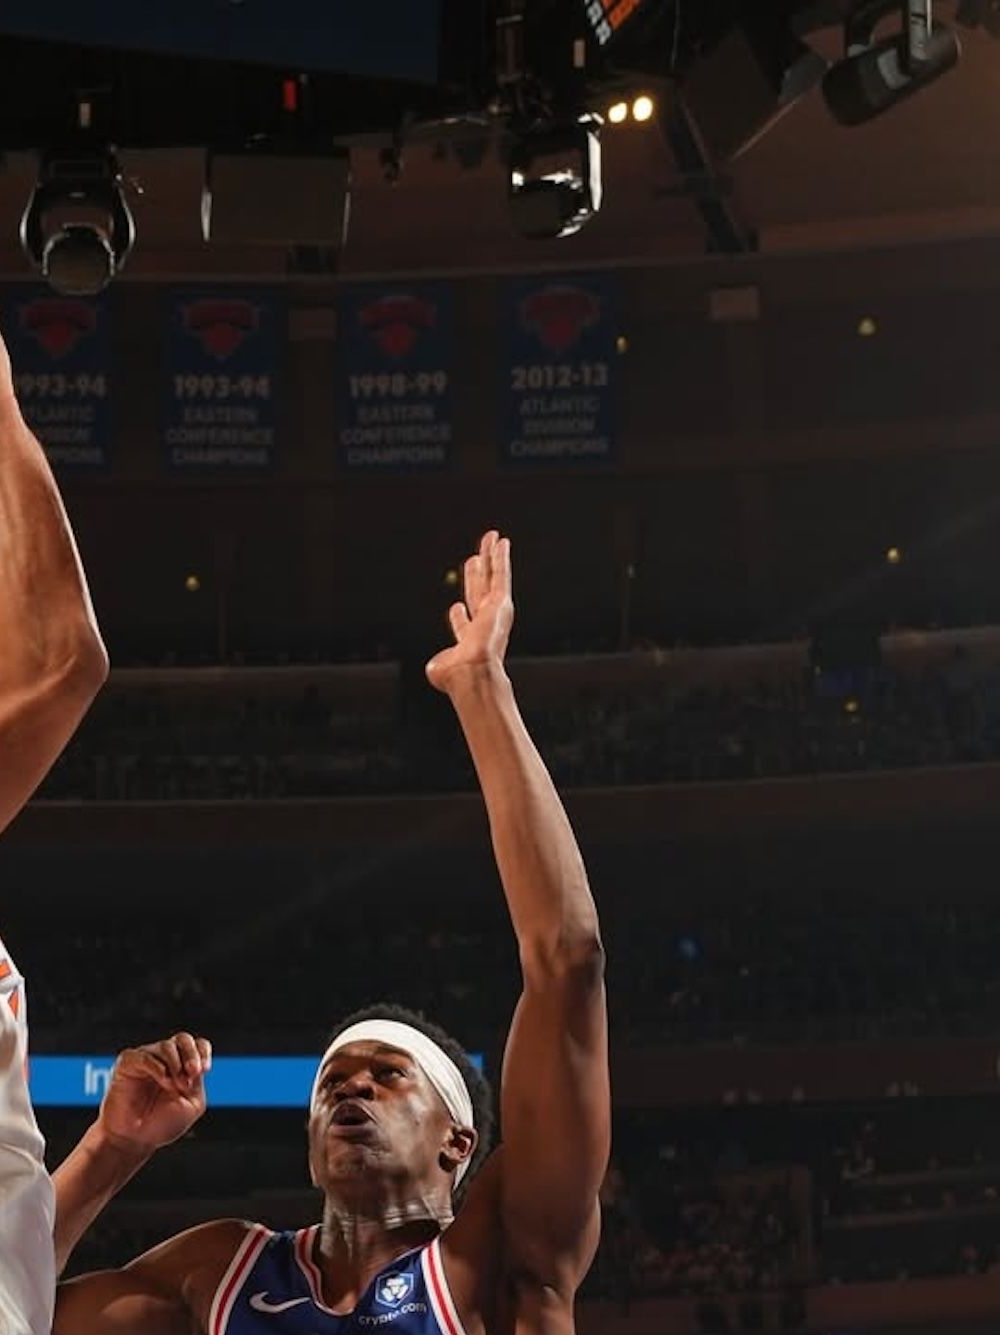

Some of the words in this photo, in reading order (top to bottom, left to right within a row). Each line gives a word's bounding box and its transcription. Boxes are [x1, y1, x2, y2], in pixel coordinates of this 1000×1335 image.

[173, 373, 270, 400] 1993-94
[348, 371, 447, 398] 1998-99
[510, 361, 609, 390] 2012-13
